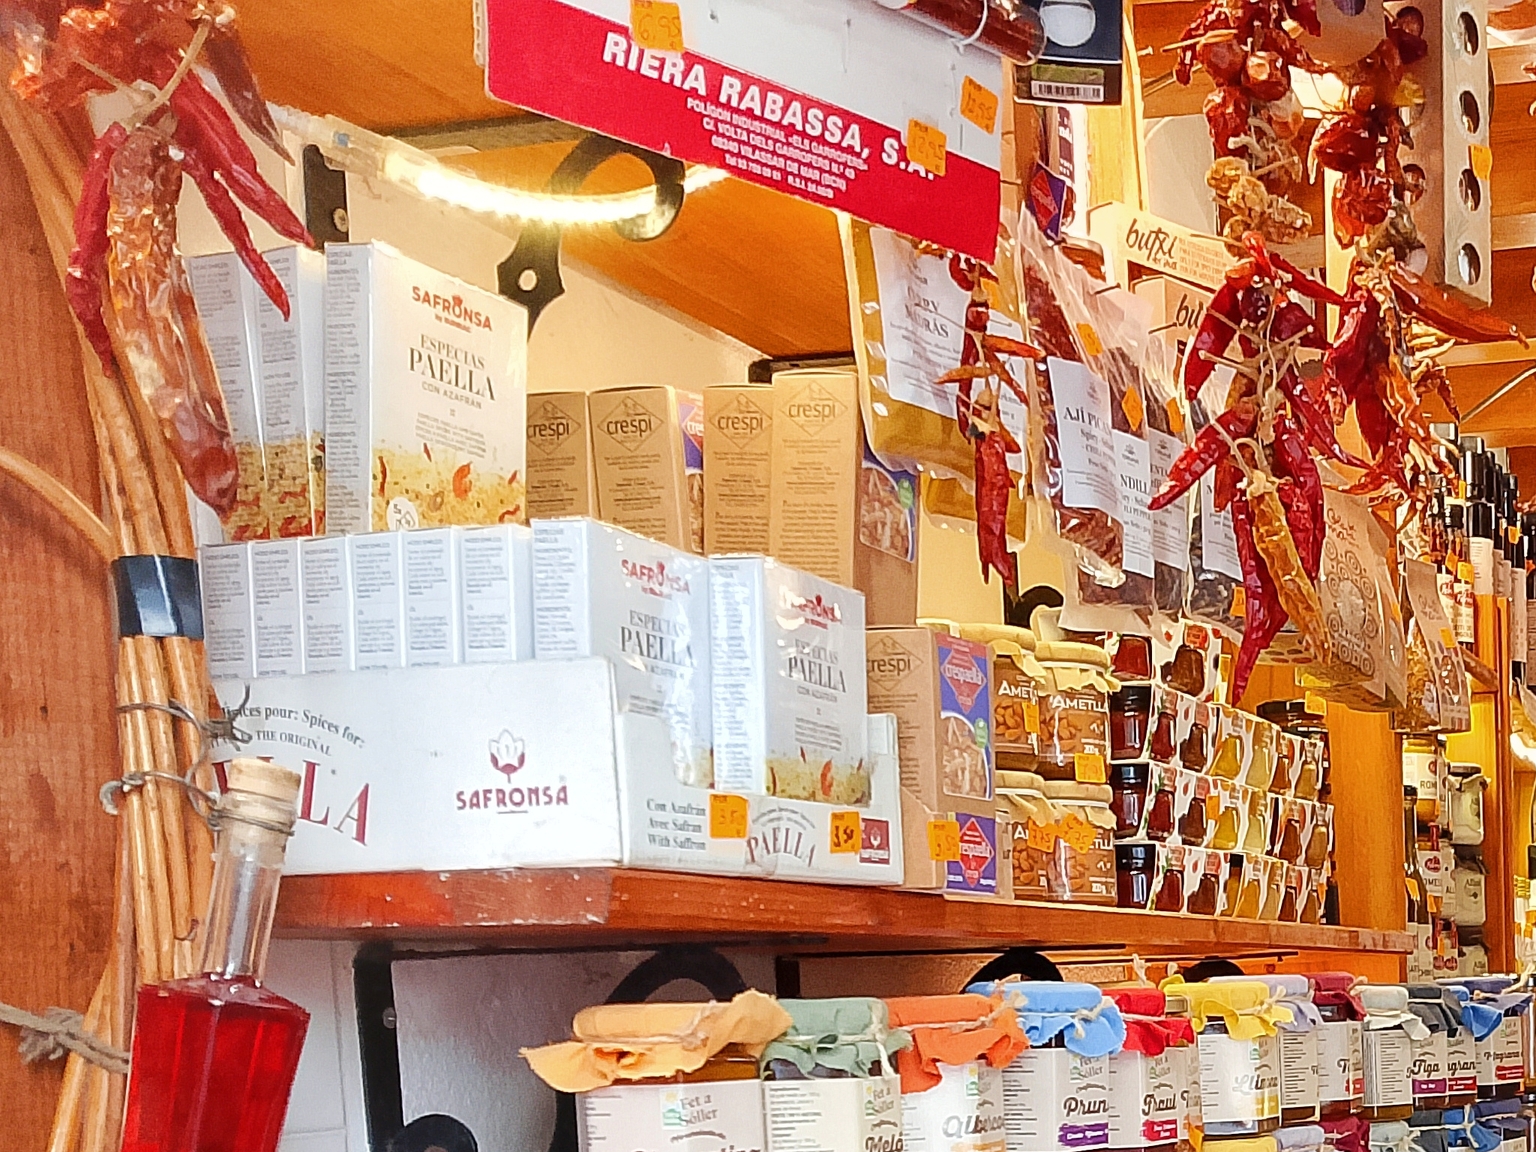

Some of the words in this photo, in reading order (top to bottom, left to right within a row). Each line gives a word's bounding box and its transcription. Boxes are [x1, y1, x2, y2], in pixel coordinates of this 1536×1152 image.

[602, 32, 707, 96] RIERA
[718, 74, 872, 158] RABASSA,
[687, 97, 730, 122] POLÍGON
[732, 114, 786, 142] INDUSTRIAL
[718, 122, 748, 141] VOLTA
[750, 134, 774, 151] DELS
[740, 143, 785, 169] VILASSAR
[786, 161, 799, 173] DE
[800, 165, 820, 182] MAR
[412, 286, 492, 332] SAFRONSA
[420, 334, 485, 370] ESPECIAS
[409, 347, 495, 402] PAELLA
[421, 381, 441, 398] CON
[788, 397, 837, 422] crespi
[527, 421, 570, 442] crespi
[606, 415, 652, 438] crespi
[717, 412, 764, 436] crespi
[620, 625, 697, 668] PAELLA
[788, 656, 846, 693] PAELLA
[265, 704, 298, 724] pour:
[302, 708, 340, 736] Spices
[342, 724, 366, 748] for:
[255, 729, 278, 743] THE
[279, 731, 333, 758] ORIGINAL
[456, 785, 569, 812] SAFRONSA
[647, 799, 668, 813] Con
[647, 818, 669, 832] Avec
[671, 819, 703, 834] Safran
[647, 834, 669, 848] With
[671, 835, 706, 851] Saffron
[747, 826, 816, 867] PAELLA
[680, 1095, 701, 1111] Fet
[1063, 1096, 1109, 1118] Prun
[680, 1108, 718, 1128] Sóller
